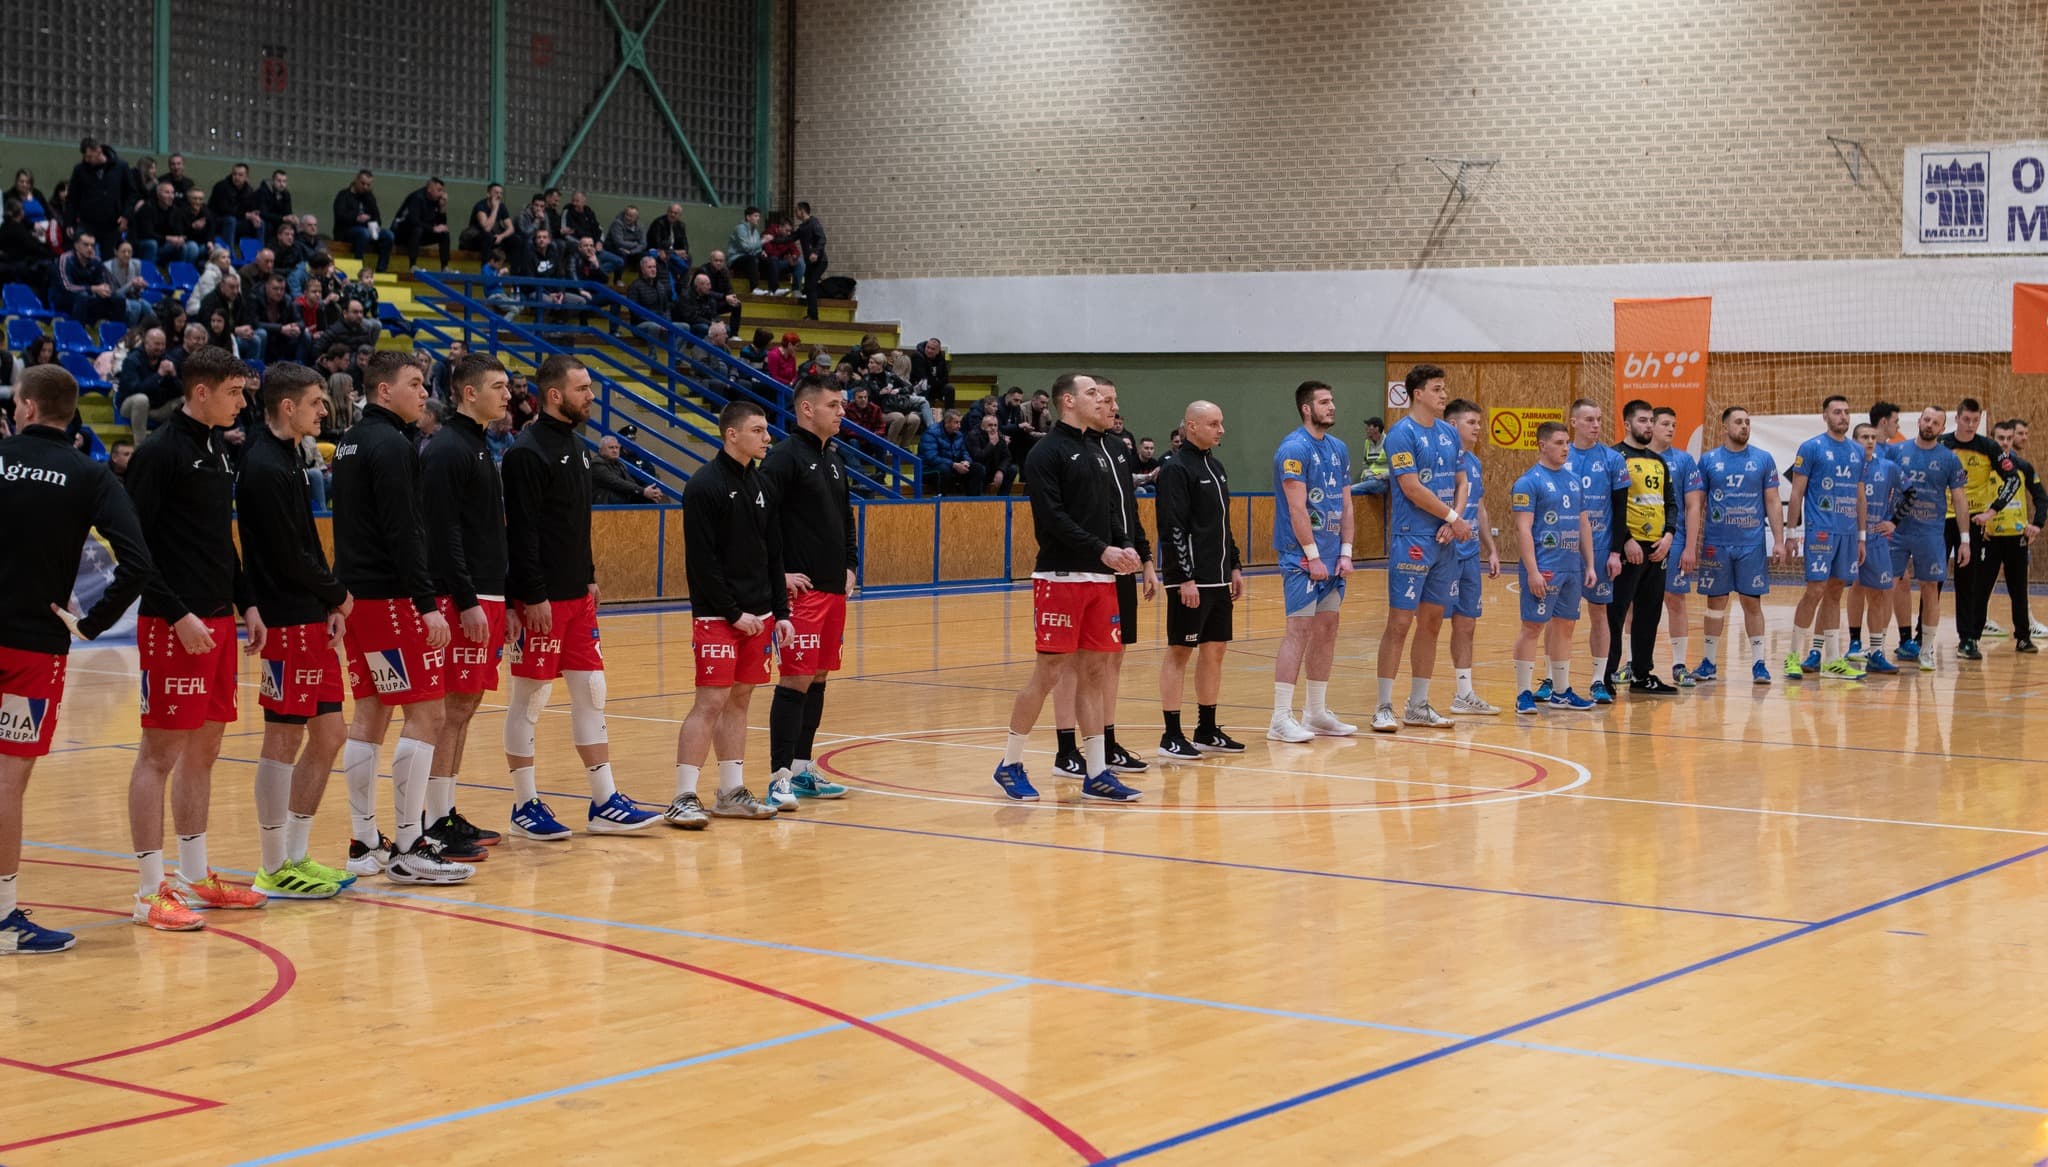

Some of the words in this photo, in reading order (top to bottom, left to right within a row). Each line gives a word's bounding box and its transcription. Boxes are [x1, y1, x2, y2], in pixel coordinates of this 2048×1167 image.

[1925, 228, 1984, 238] MAGLAJ
[1624, 352, 1660, 378] bh
[582, 450, 590, 469] 6
[831, 464, 839, 479] 3
[1835, 465, 1851, 479] 14
[1910, 470, 1926, 483] 22
[1645, 475, 1659, 489] 63
[1726, 474, 1744, 488] 17
[755, 491, 765, 508] 4
[1562, 495, 1570, 508] 8
[1811, 561, 1828, 574] 14
[1700, 577, 1714, 589] 17
[1404, 585, 1416, 600] 4
[1537, 603, 1546, 615] 8
[1041, 612, 1073, 628] FEAL
[790, 634, 820, 649] FEA
[701, 644, 735, 659] FEAL
[164, 677, 207, 695] FEAL
[0, 712, 32, 730] DIA
